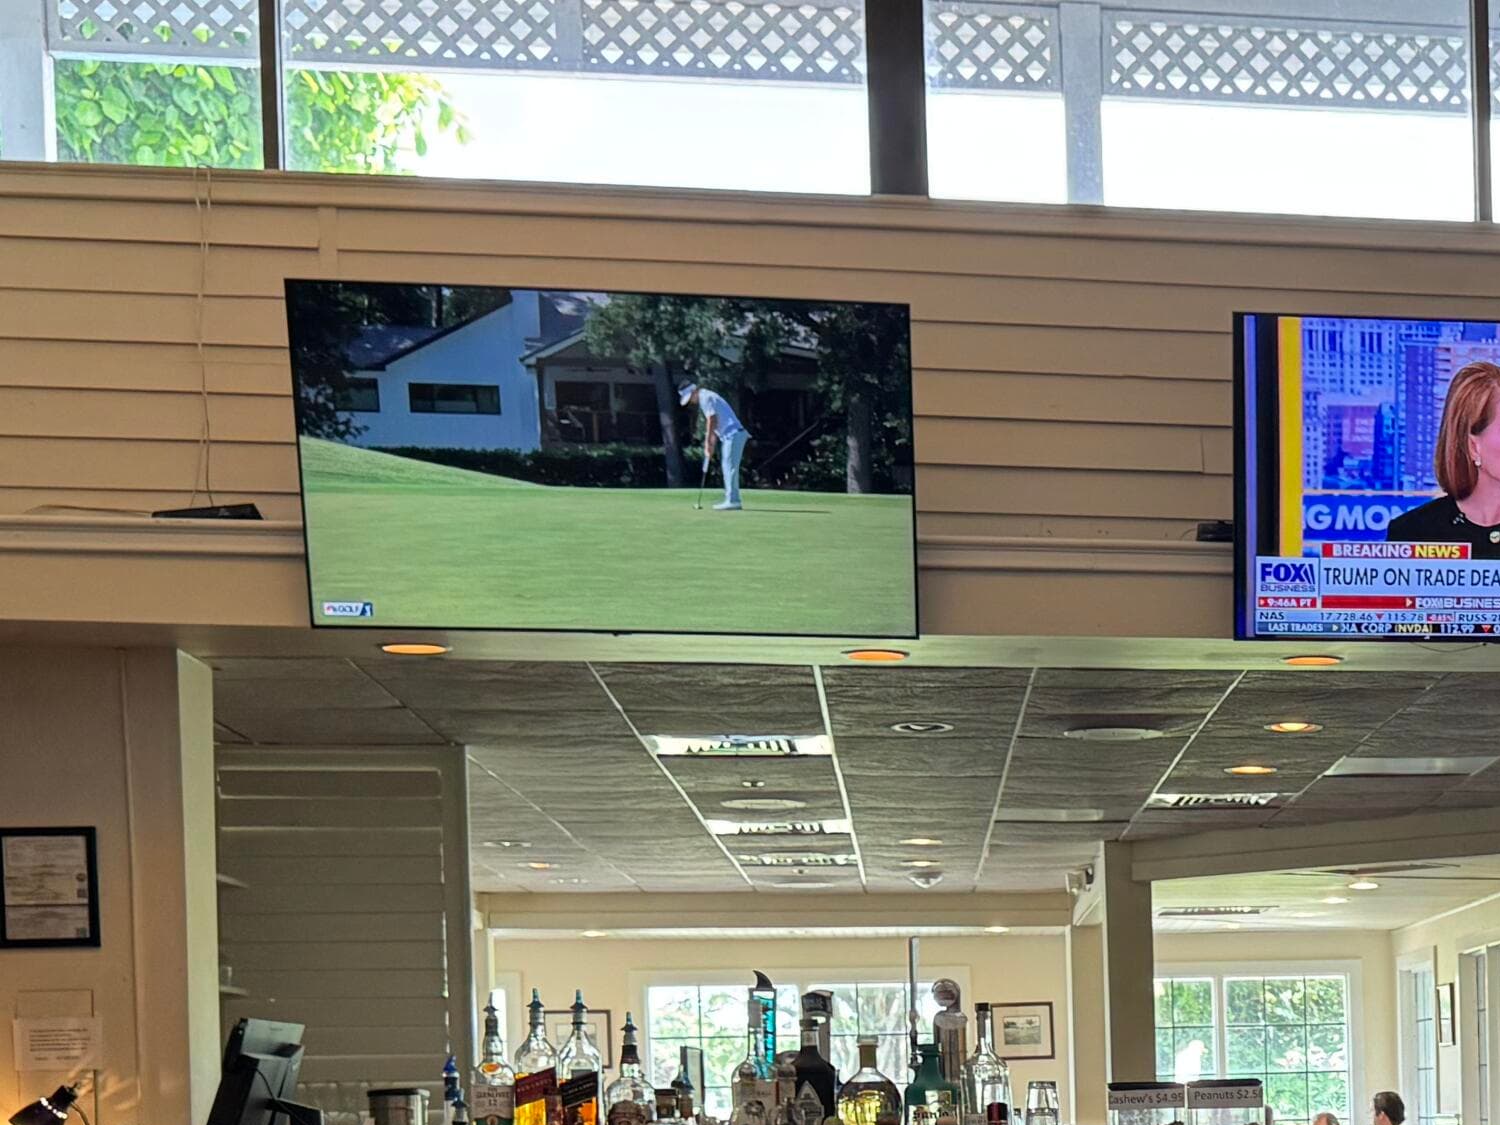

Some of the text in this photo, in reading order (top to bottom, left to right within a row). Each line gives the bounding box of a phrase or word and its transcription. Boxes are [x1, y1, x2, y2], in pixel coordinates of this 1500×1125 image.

[1332, 543, 1461, 558] BREAKING NEWS
[1324, 568, 1378, 585] TRUMP
[1383, 568, 1410, 586] ON
[1416, 569, 1466, 587] TRADE
[1260, 584, 1316, 593] BUSINESS
[1300, 598, 1312, 608] PT
[1259, 612, 1285, 620] NAS
[1388, 613, 1424, 621] 115.78
[1458, 614, 1488, 622] RUSS
[1268, 623, 1323, 632] LAST TRADES
[1361, 624, 1392, 633] CORP
[1194, 1090, 1234, 1101] Peanuts
